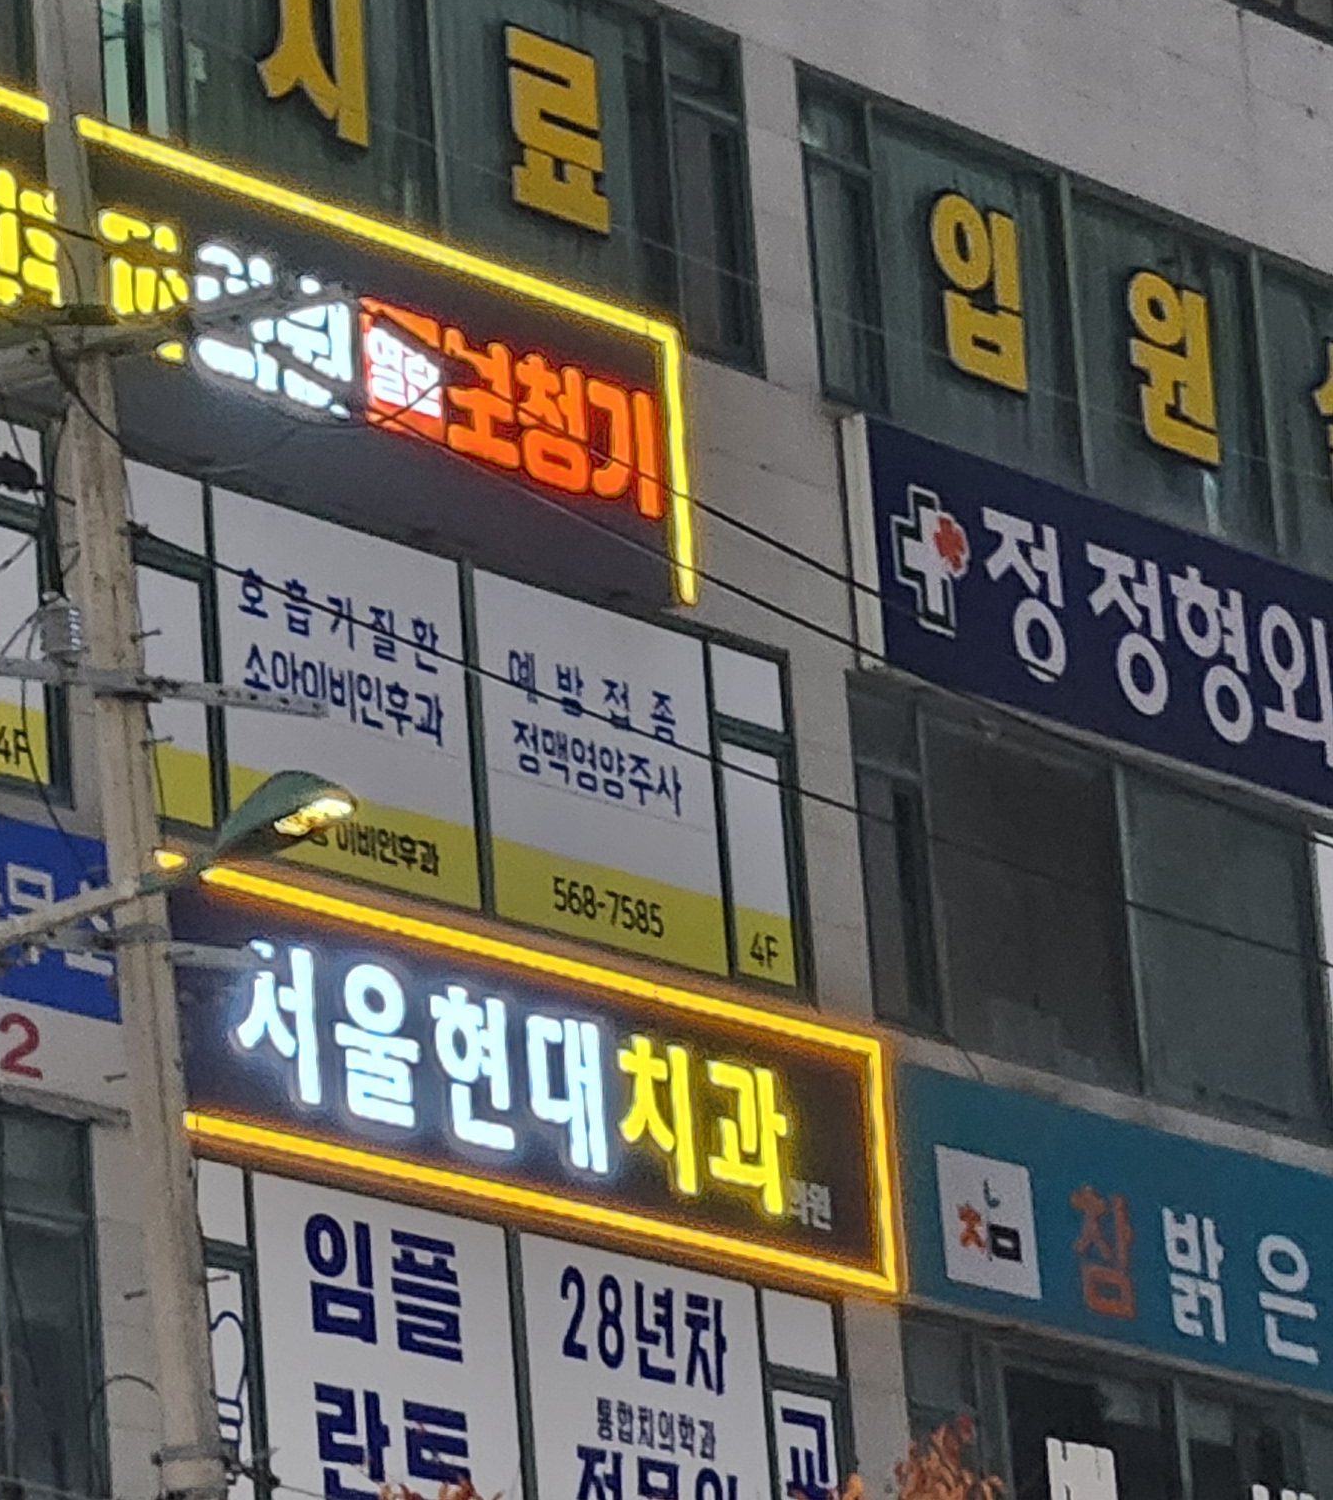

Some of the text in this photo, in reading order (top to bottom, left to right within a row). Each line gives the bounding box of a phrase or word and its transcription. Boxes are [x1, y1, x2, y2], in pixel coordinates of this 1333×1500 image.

[933, 190, 1333, 468] 입원
[441, 325, 665, 522] 보청기
[237, 566, 441, 676] 호흡기질환
[981, 504, 1069, 684] 정
[243, 642, 447, 748] 소아이비인후과
[507, 648, 679, 746] 예방접종
[513, 720, 683, 820] 정맥영양주사
[551, 874, 667, 942] 568-7585
[749, 930, 781, 968] 4F
[303, 1212, 467, 1366] 임플
[559, 1266, 729, 1396] 28년차
